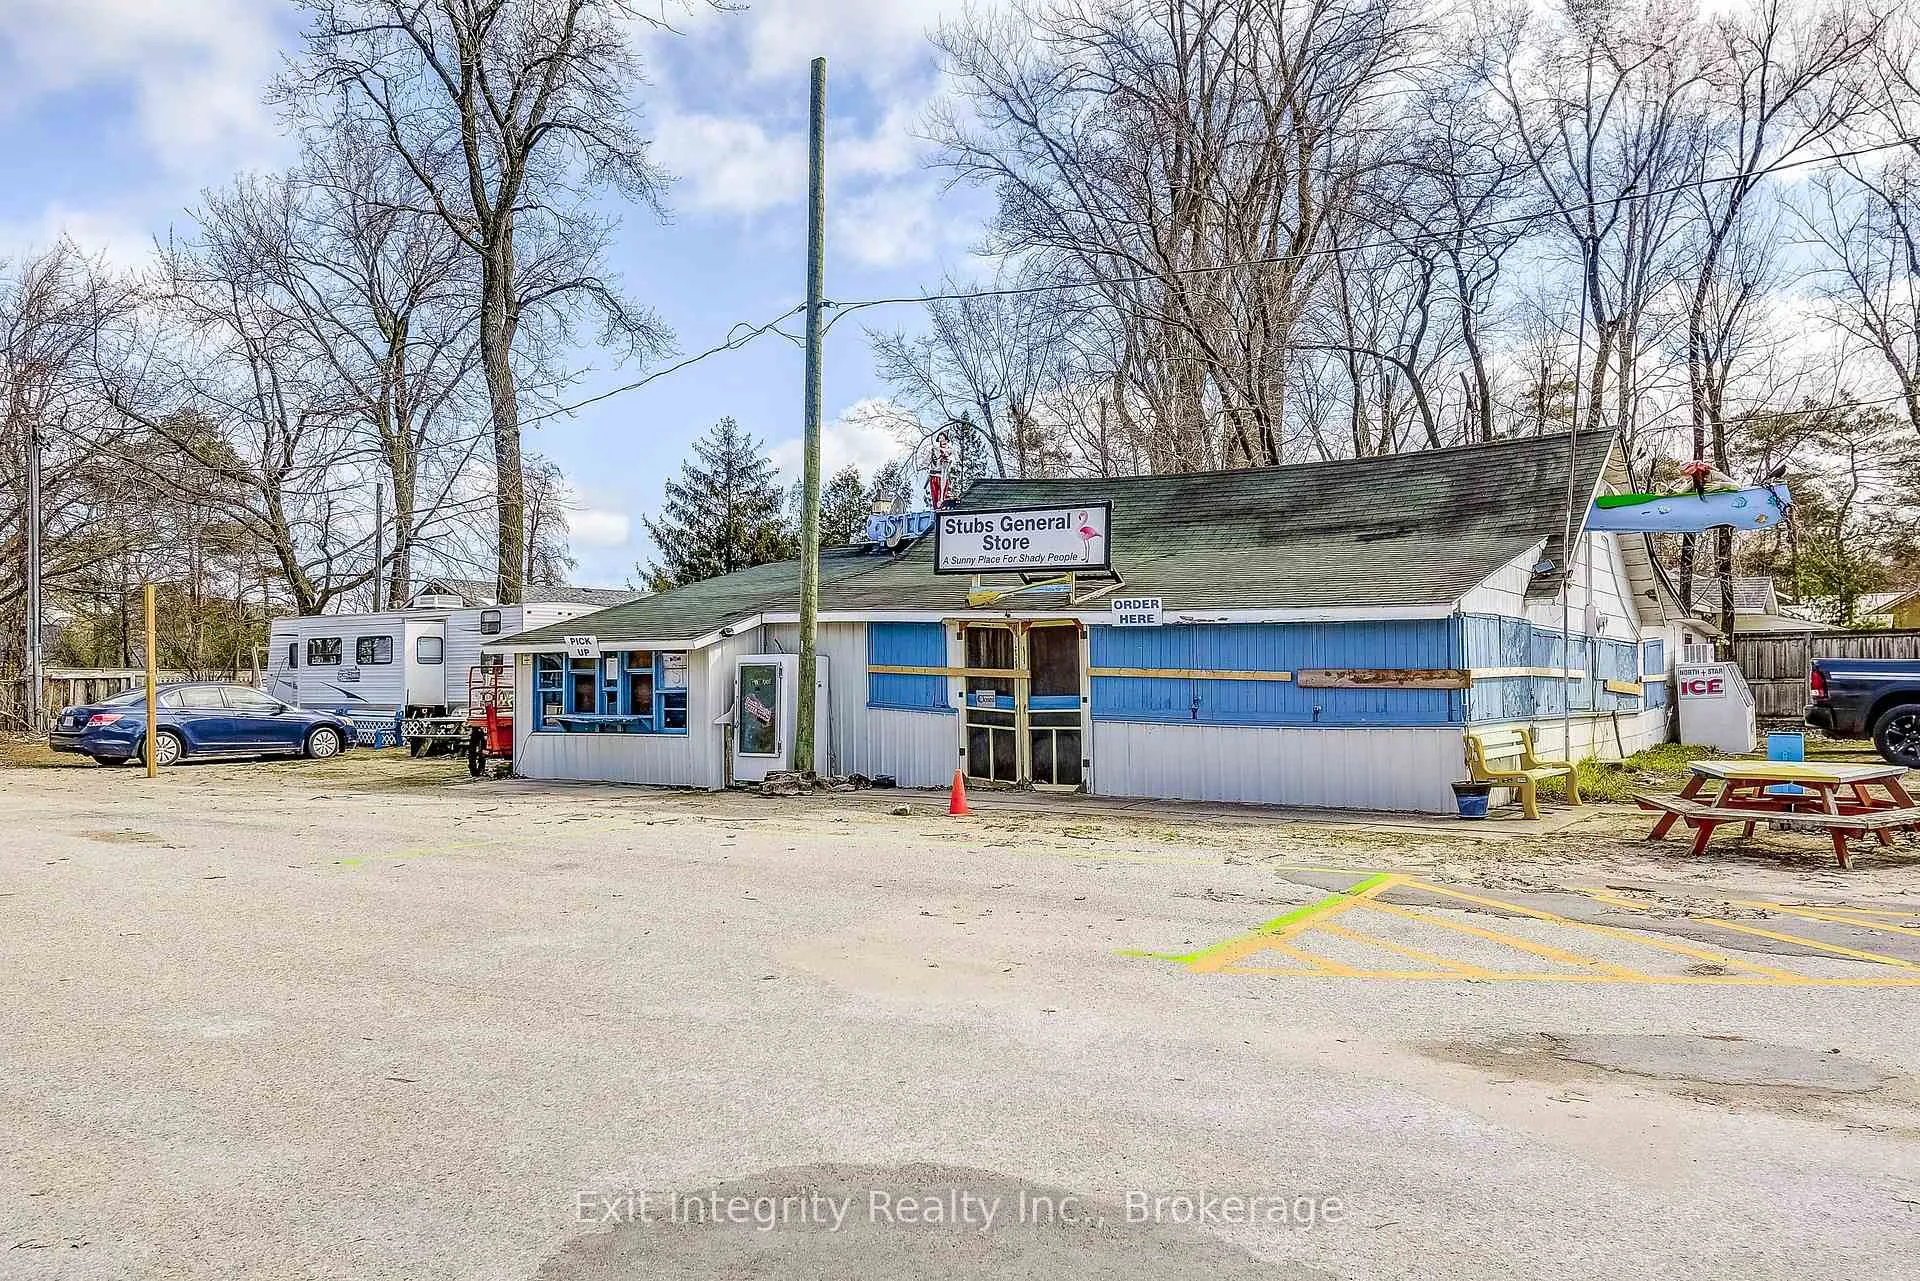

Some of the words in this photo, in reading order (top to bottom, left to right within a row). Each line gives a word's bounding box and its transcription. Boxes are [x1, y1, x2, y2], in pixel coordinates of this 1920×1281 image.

[945, 518, 994, 534] Stubs
[1000, 513, 1071, 532] General
[982, 535, 1030, 551] Store
[943, 557, 950, 565] A
[951, 556, 976, 567] Sunny
[978, 555, 1000, 564] Place
[1003, 554, 1017, 563] For
[1019, 553, 1046, 564] Shady
[1048, 551, 1078, 563] People
[1113, 599, 1160, 610] ORDER
[1119, 614, 1155, 624] HERE
[570, 637, 592, 646] PICK
[577, 648, 590, 657] UP
